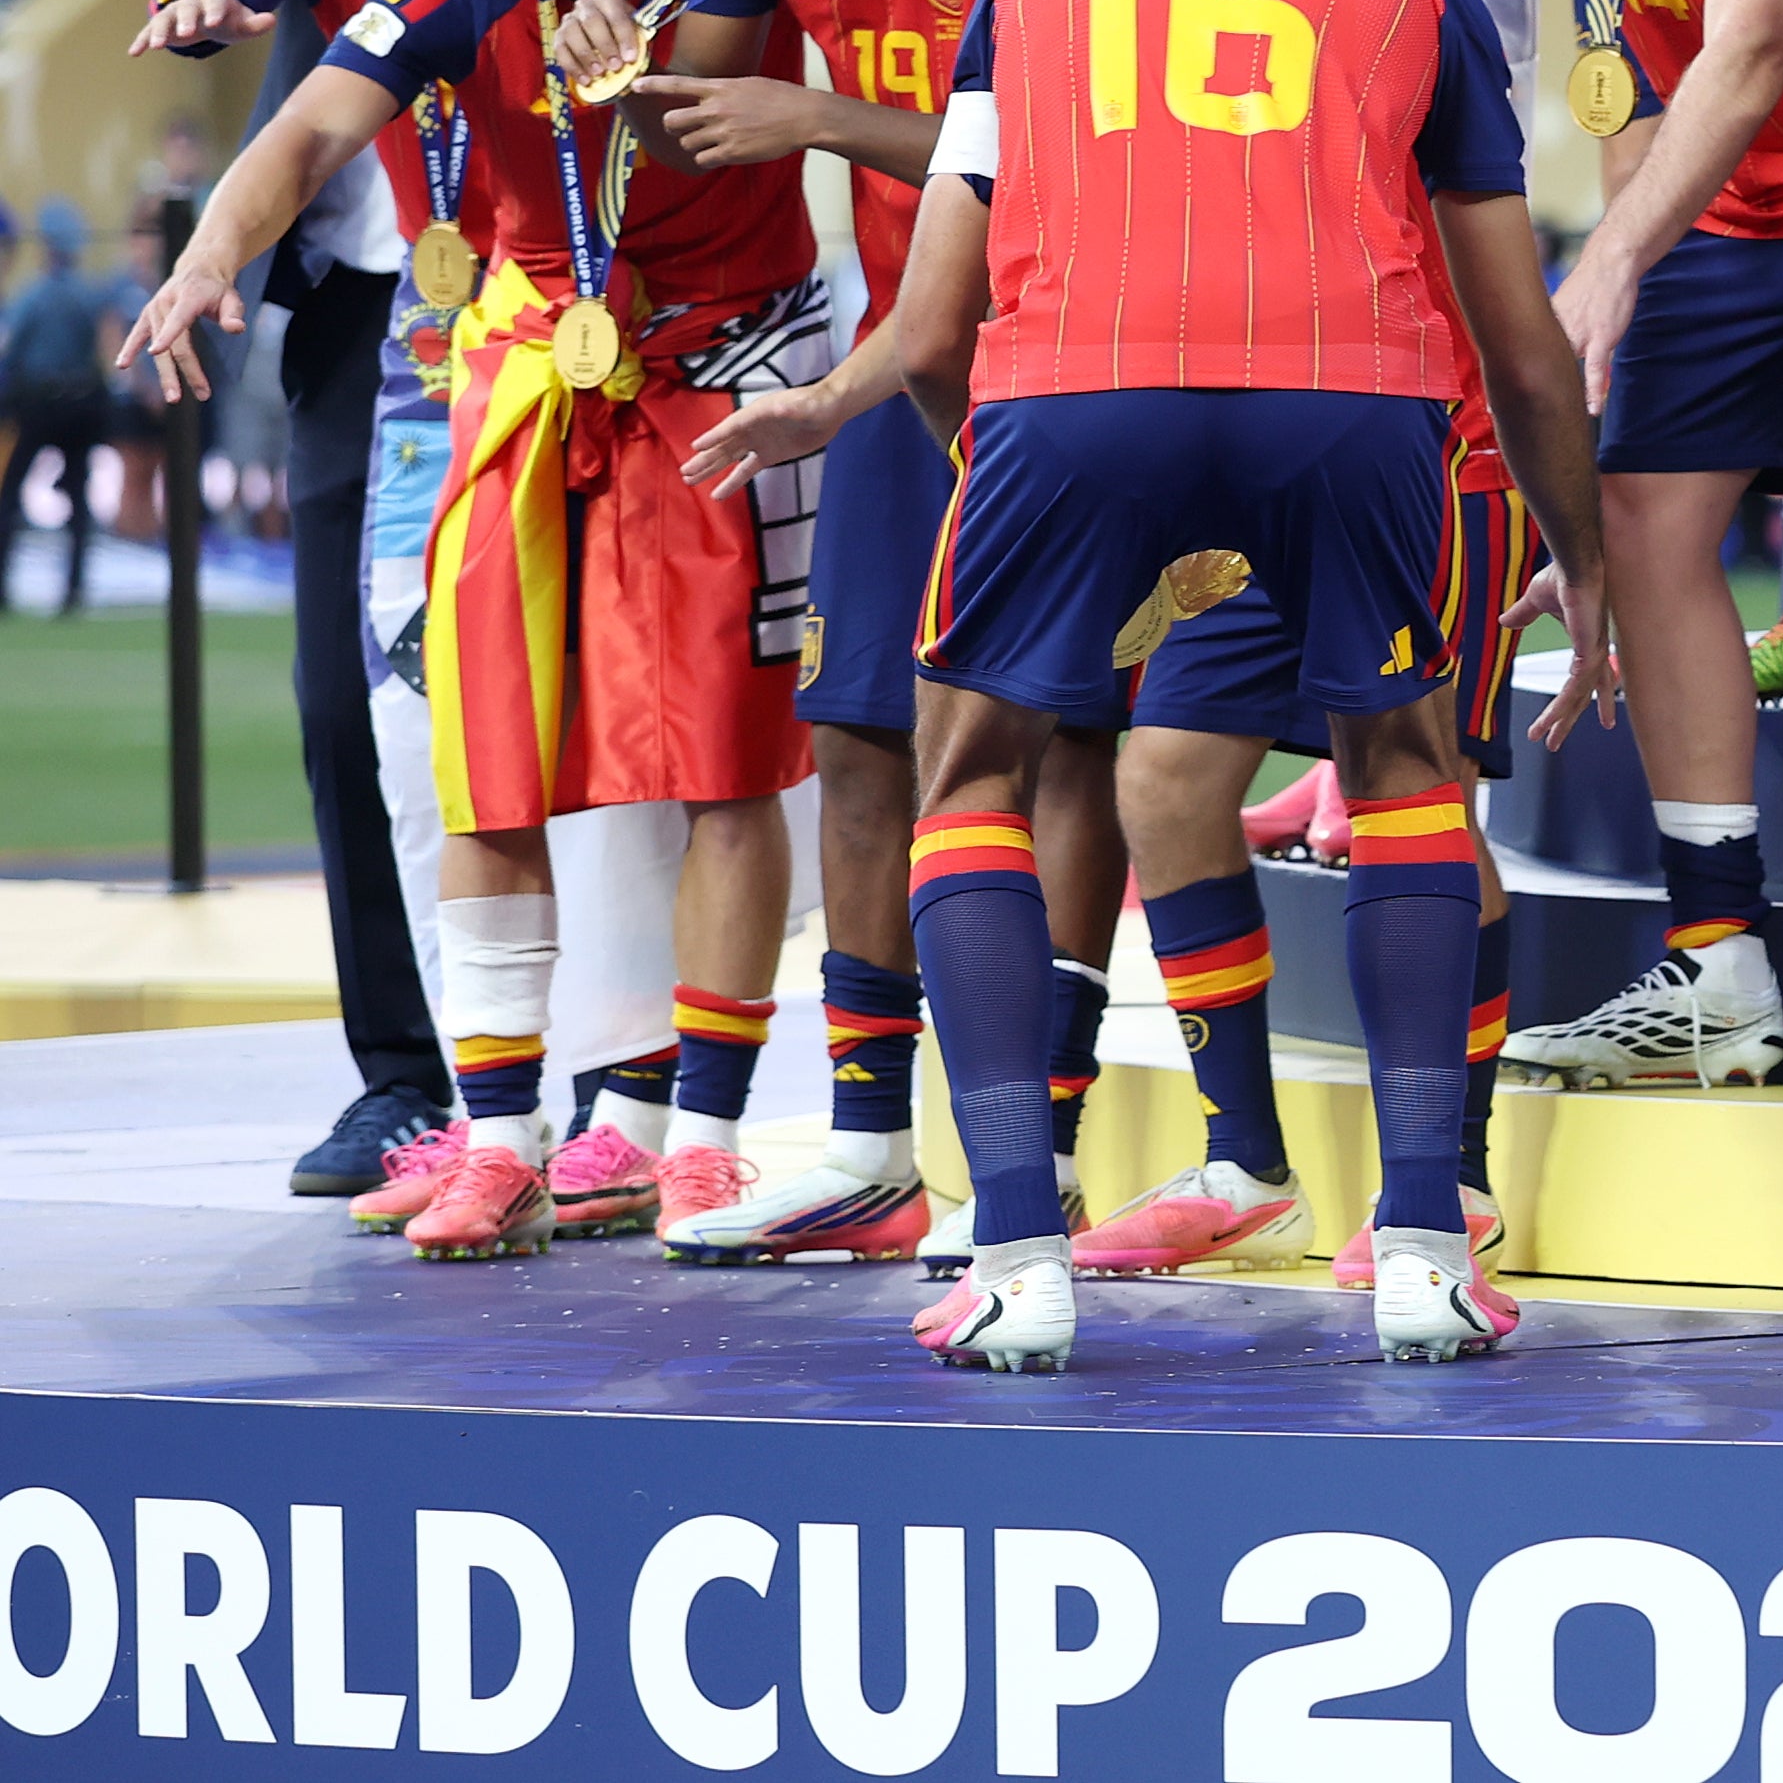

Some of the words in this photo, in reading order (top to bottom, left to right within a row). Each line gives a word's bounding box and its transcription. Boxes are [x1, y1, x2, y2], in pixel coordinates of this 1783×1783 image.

[852, 28, 935, 115] 19
[427, 149, 444, 184] FIFA
[562, 151, 580, 188] FIFA
[566, 188, 589, 247] WORLD
[576, 248, 595, 284] CUP
[0, 1487, 573, 1754] ORLD
[630, 1514, 1158, 1777] CUP
